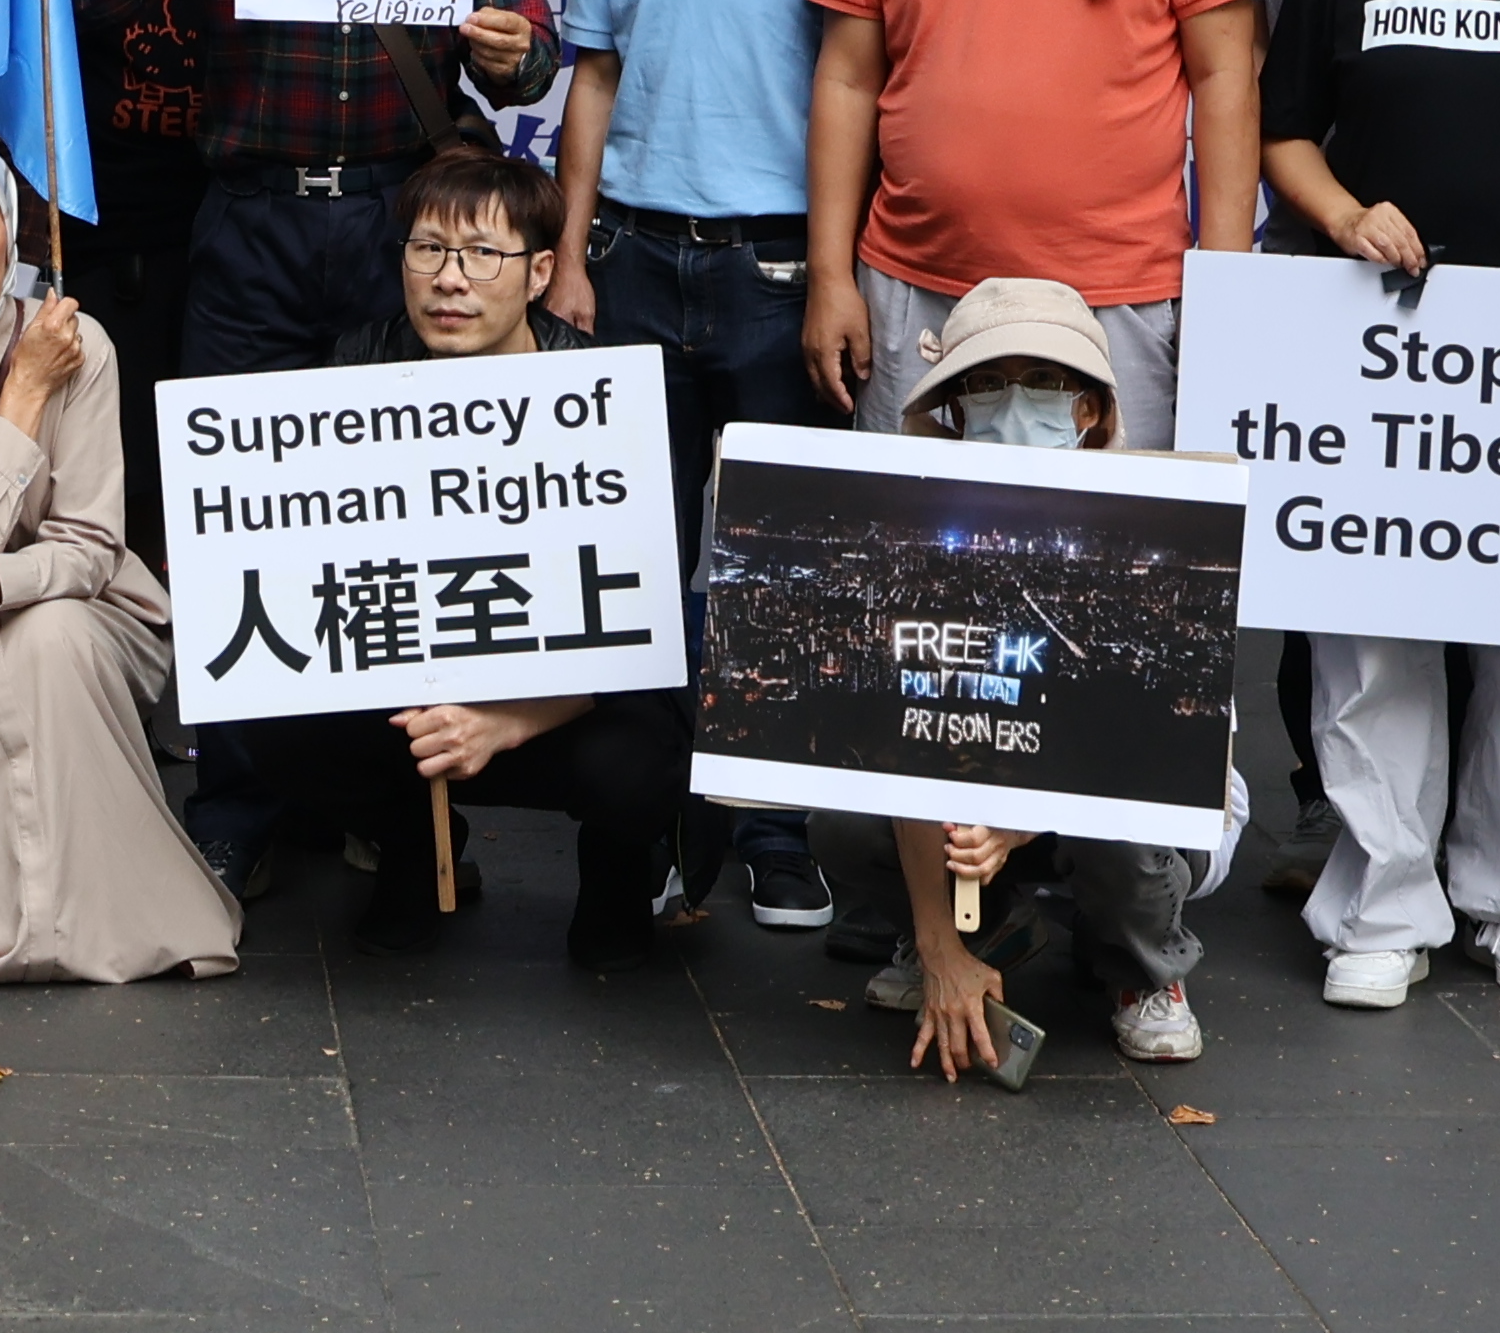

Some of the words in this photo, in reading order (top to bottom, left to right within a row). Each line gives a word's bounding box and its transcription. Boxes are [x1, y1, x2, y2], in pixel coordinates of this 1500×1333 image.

[1372, 6, 1447, 37] HONG
[185, 395, 532, 462] Supremacy
[552, 377, 614, 428] of
[1231, 402, 1347, 467] the
[192, 474, 408, 535] Human
[430, 458, 628, 526] Rights
[204, 544, 653, 681] 人權至上
[894, 620, 988, 664] FREE
[997, 633, 1048, 674] HK
[900, 667, 1021, 706] POLITICAL
